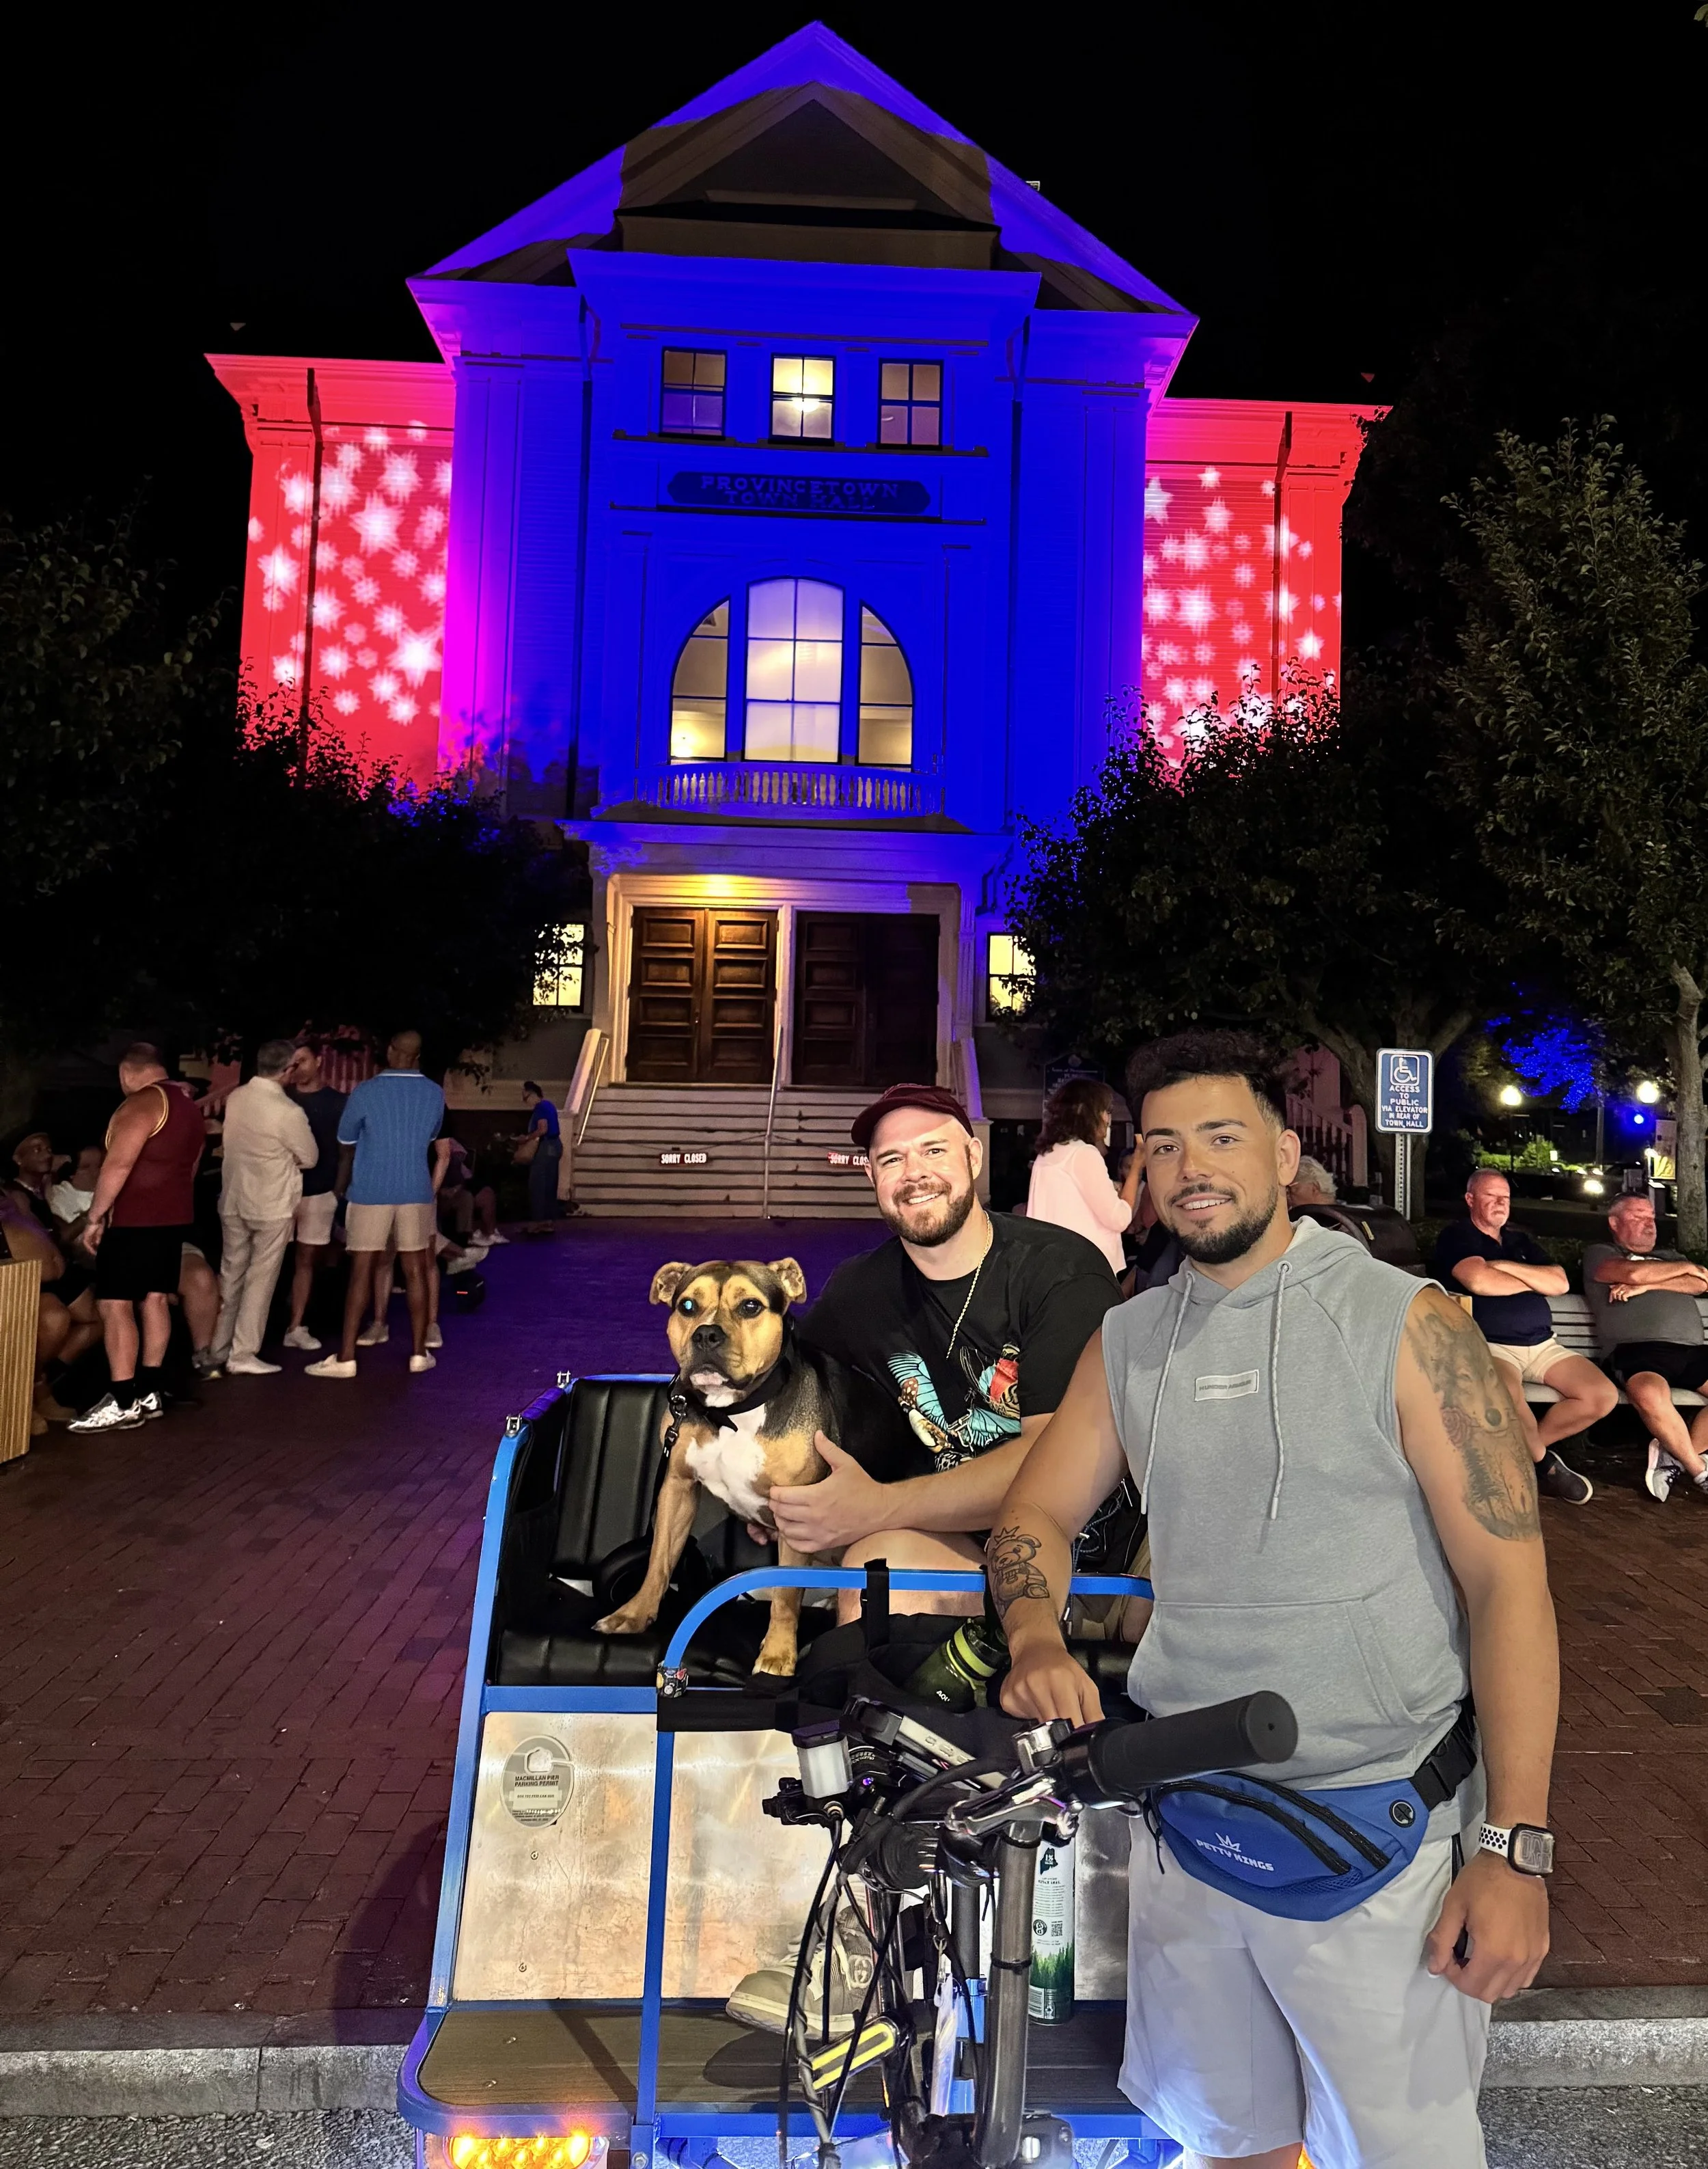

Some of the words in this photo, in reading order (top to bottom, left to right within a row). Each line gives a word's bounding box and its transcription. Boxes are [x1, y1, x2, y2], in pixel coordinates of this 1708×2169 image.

[700, 476, 898, 498] PROVINCETOWN
[724, 491, 798, 506] TOWN
[810, 494, 874, 509] HALL
[661, 1154, 680, 1164] SORRY
[684, 1153, 706, 1164] CLOSED
[829, 1154, 849, 1164] SORRY
[853, 1156, 869, 1165] CLOS
[1196, 1839, 1232, 1857] PETTY
[1233, 1853, 1274, 1871] KINGS
